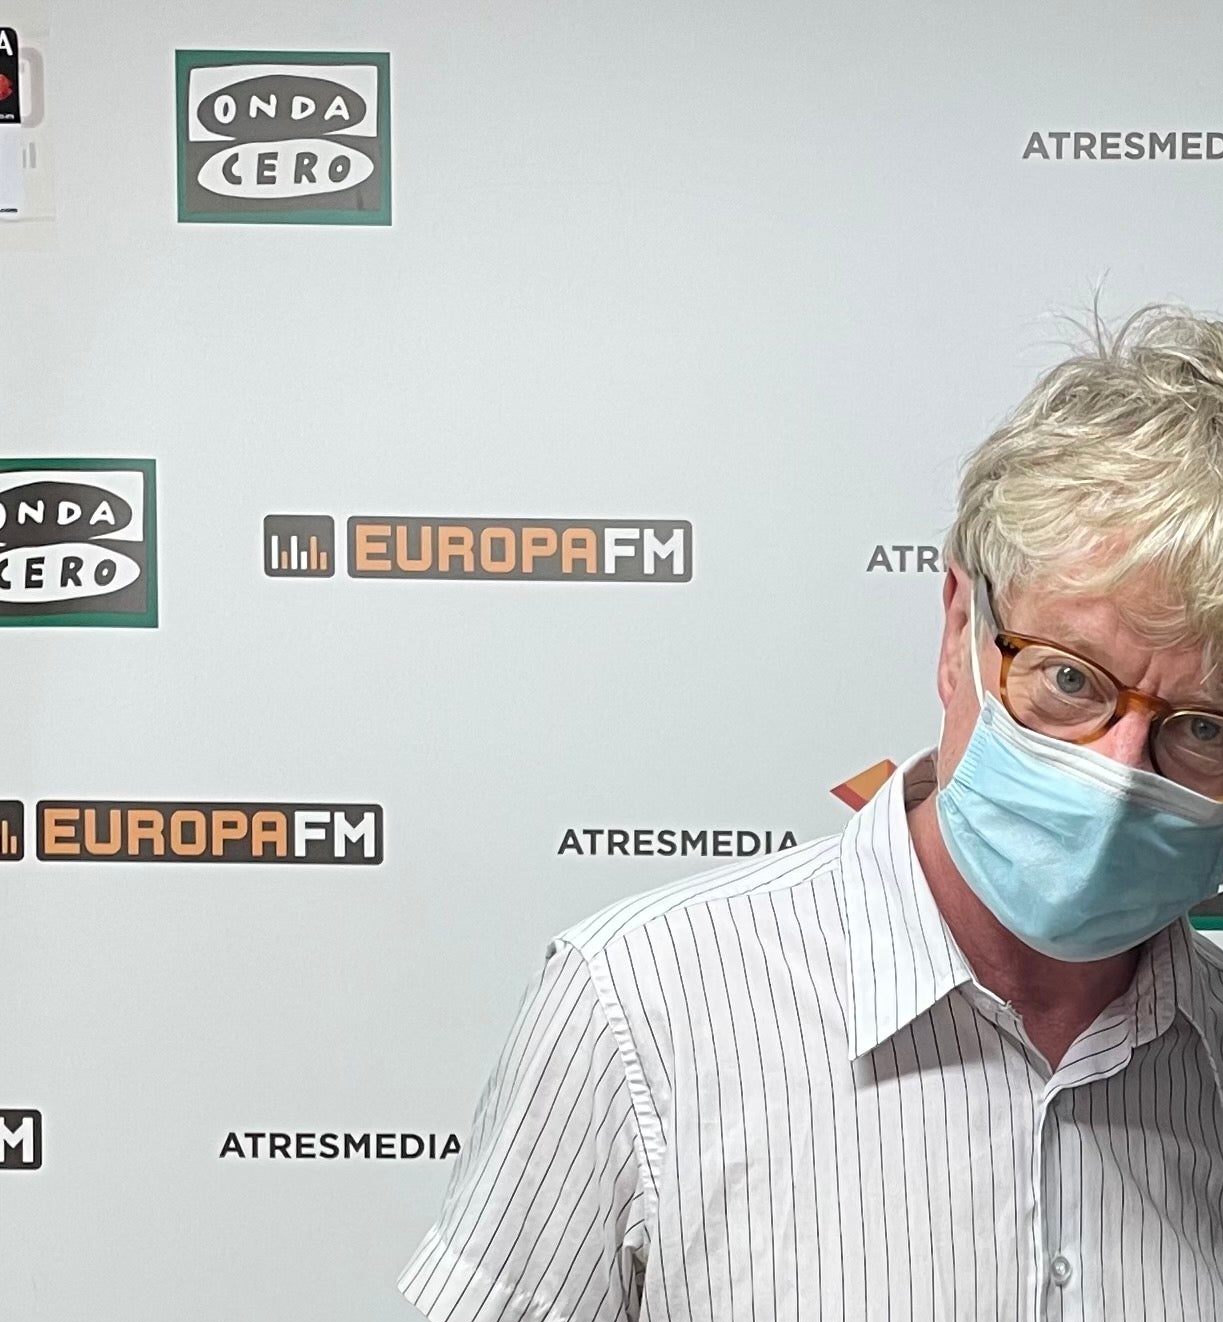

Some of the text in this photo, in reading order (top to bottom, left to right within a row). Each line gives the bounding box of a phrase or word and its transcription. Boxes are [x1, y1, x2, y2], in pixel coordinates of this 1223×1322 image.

[214, 94, 350, 124] ONDA
[222, 151, 351, 185] CERO
[0, 500, 116, 528] NDA
[866, 544, 947, 572] ATR
[557, 828, 798, 857] ATRESMEDIA
[219, 1132, 461, 1159] ATRESMEDIA
